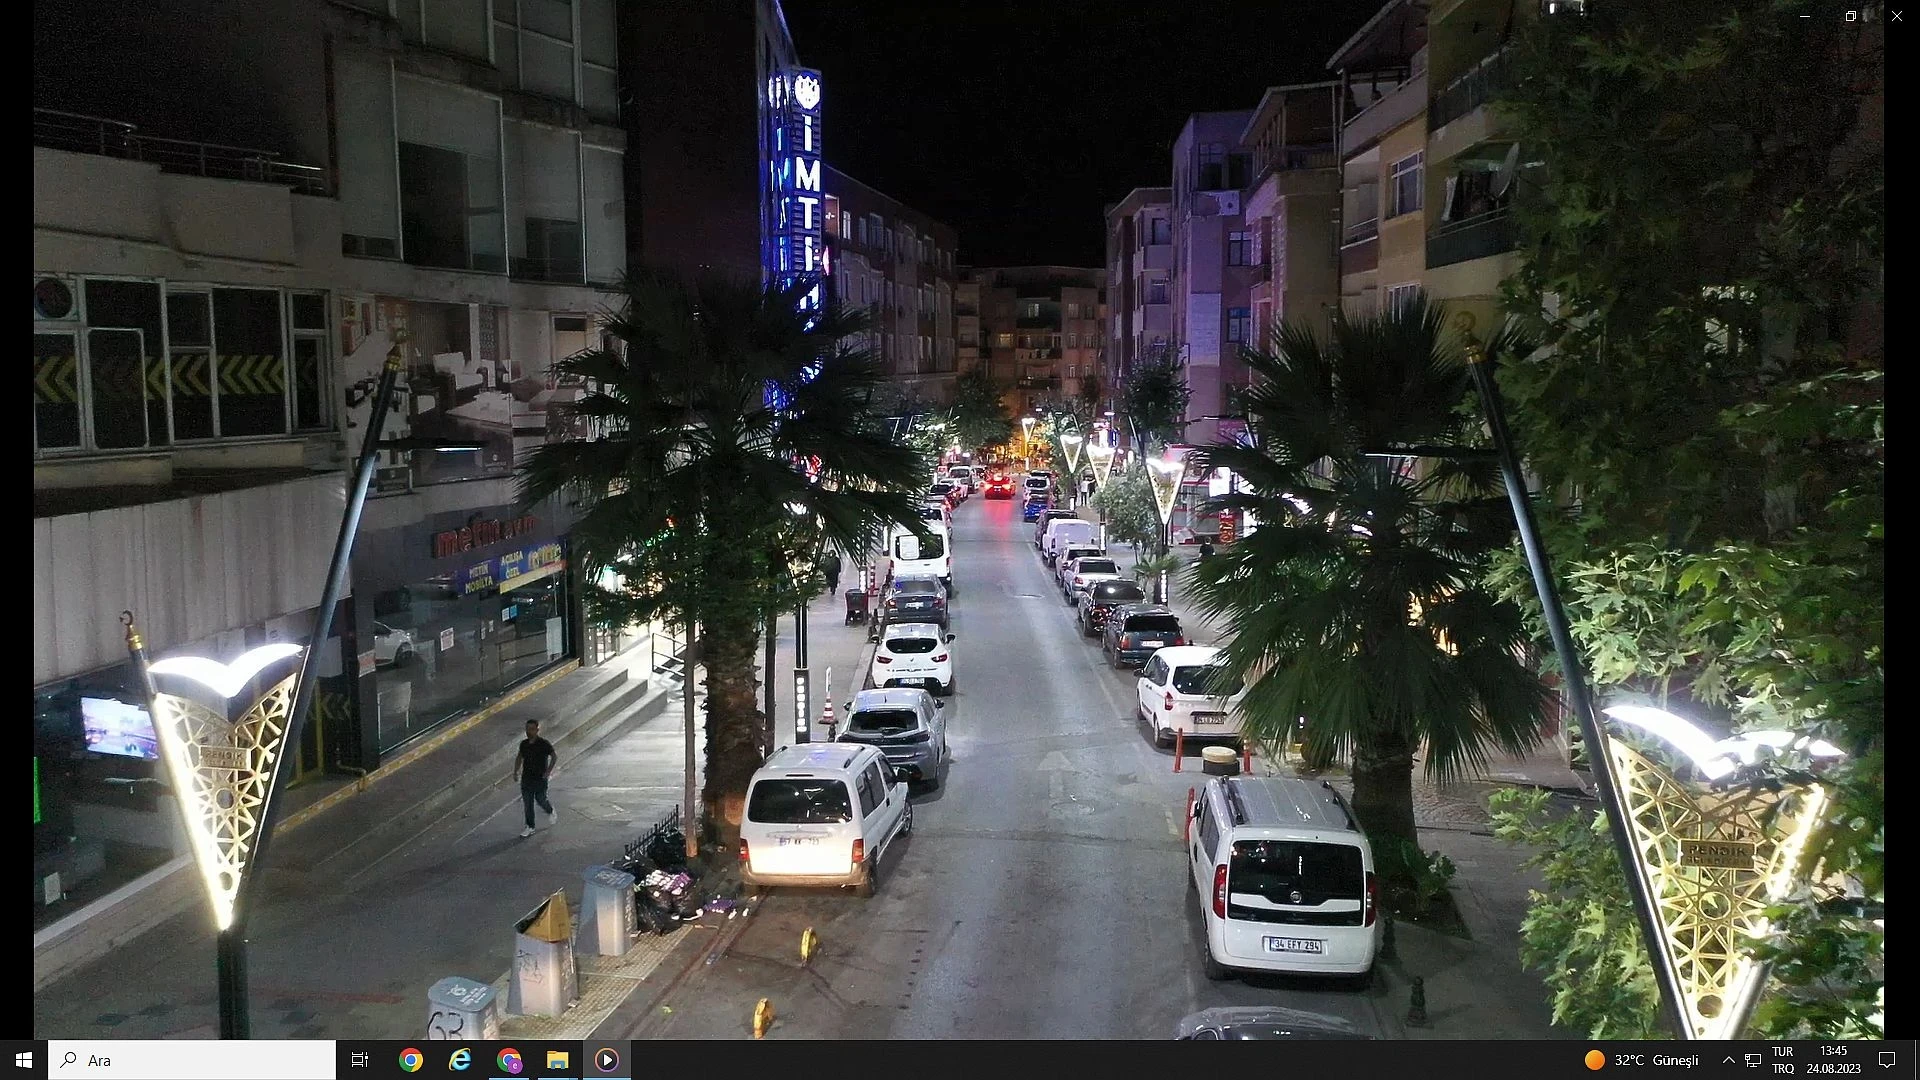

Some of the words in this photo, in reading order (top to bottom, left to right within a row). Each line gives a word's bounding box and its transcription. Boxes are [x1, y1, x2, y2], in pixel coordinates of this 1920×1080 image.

[1275, 940, 1285, 948] 34
[1287, 940, 1302, 949] EFY
[1305, 941, 1320, 950] 294
